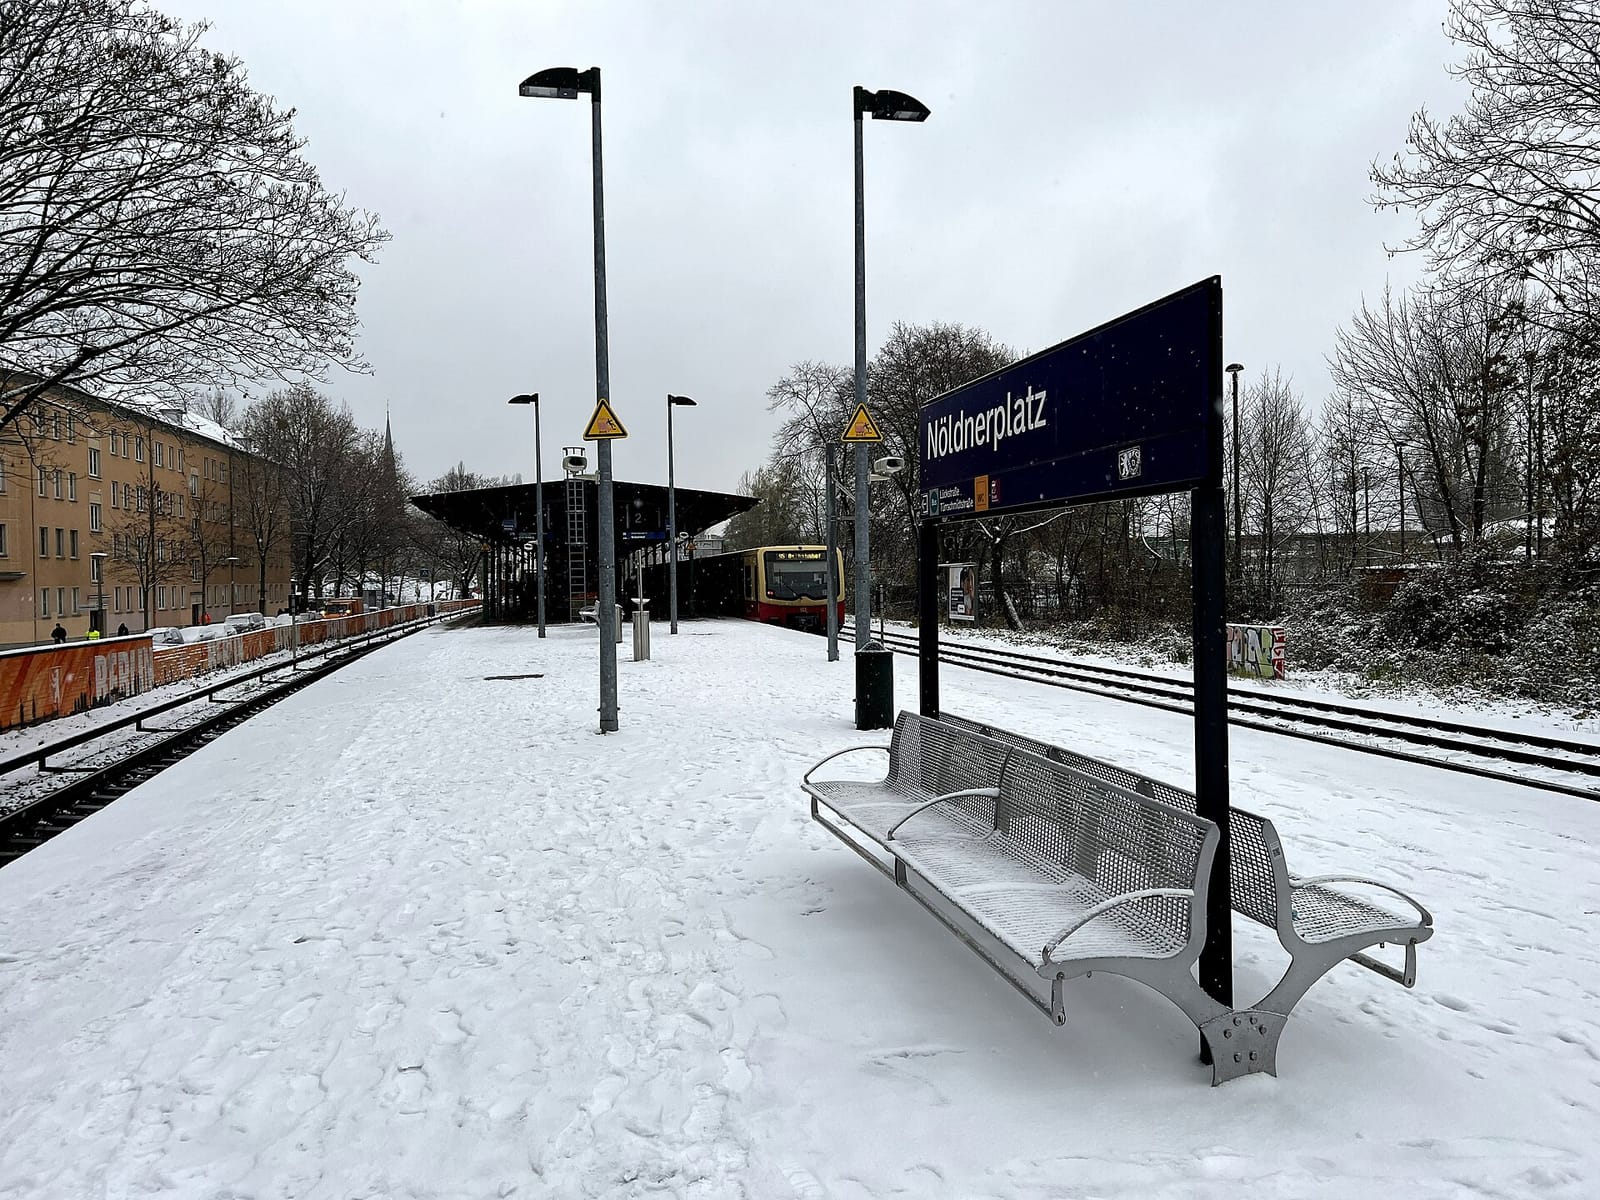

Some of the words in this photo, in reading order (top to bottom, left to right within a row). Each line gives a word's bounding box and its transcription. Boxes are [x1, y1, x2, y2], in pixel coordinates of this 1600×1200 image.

[927, 385, 1047, 460] Nöldnerplatz
[634, 512, 643, 524] 2
[94, 646, 153, 700] BERLIN
